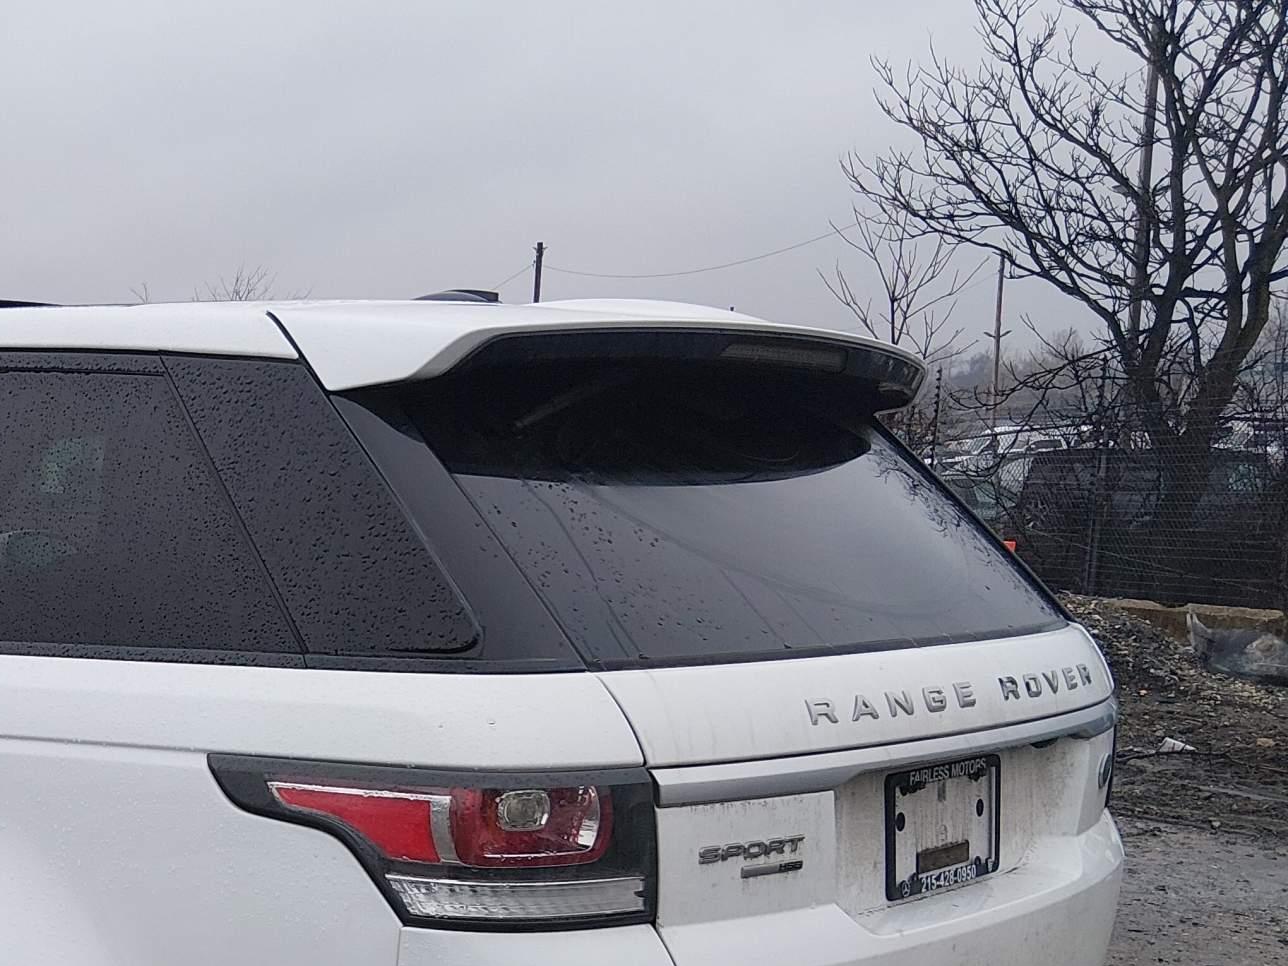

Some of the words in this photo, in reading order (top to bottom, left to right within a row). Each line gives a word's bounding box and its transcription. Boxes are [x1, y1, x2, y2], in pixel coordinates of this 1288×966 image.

[805, 681, 976, 725] RANGE
[997, 663, 1092, 701] ROVER
[909, 764, 949, 785] FAIRLESS
[951, 758, 987, 777] MOTORS
[698, 834, 805, 865] SPORT
[921, 864, 977, 892] 215-428-0950
